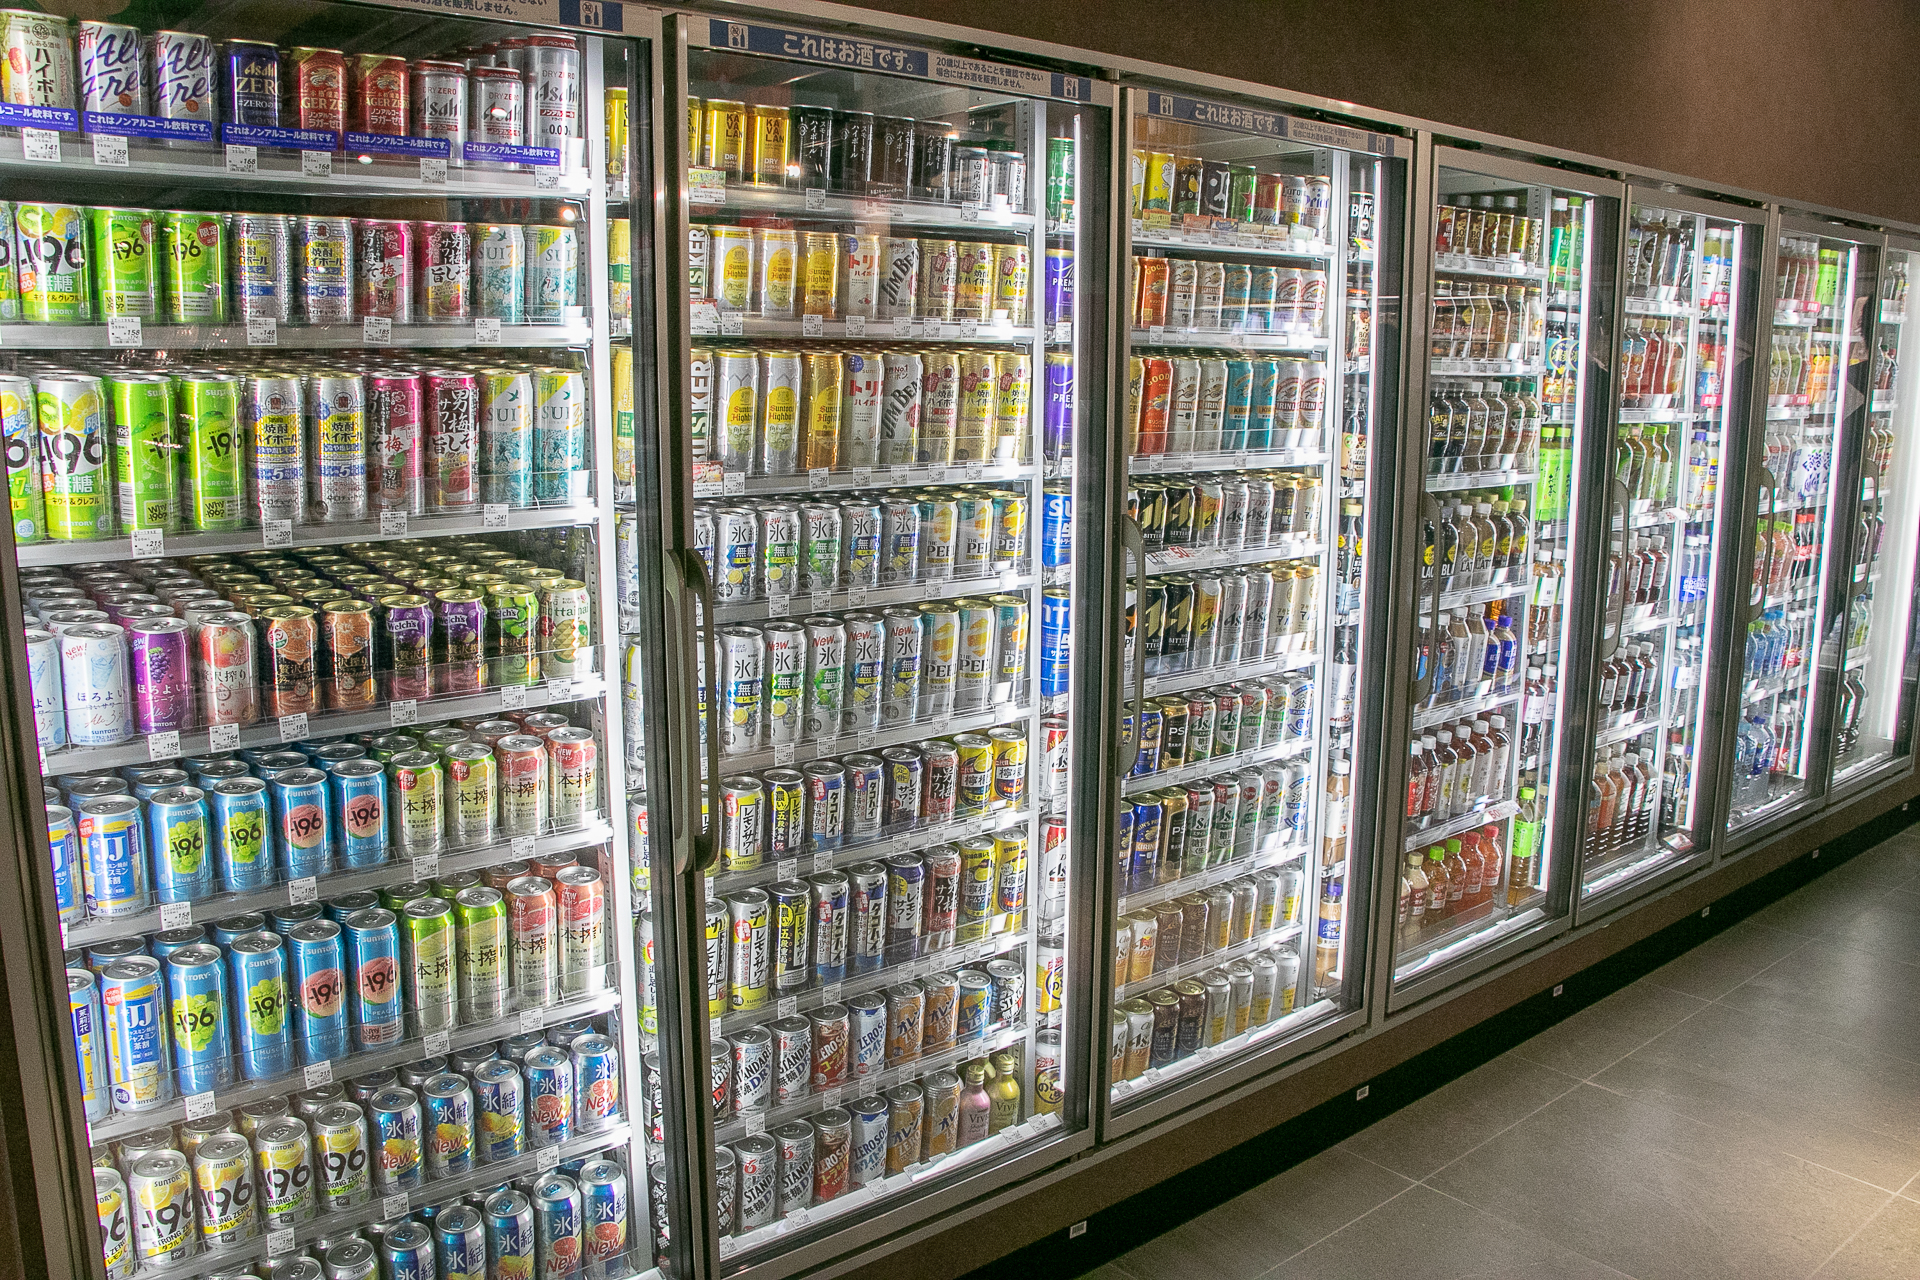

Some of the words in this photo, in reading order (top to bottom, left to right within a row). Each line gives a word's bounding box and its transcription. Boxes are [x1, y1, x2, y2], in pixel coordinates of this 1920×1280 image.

[84, 30, 144, 76] All
[157, 38, 217, 82] All
[783, 31, 915, 73] これはお酒です。
[244, 61, 276, 76] Asahi
[542, 69, 557, 78] DRY
[936, 56, 1044, 82] 20歳以上であることを確認できない
[936, 67, 1026, 90] 場合にはお酒を販売しません。
[437, 87, 457, 95] ZERO
[416, 97, 462, 118] Asahi
[726, 113, 740, 123] KA
[1194, 102, 1280, 133] これはお酒です。
[88, 114, 209, 133] これはノンアルコール飲料です。
[726, 122, 740, 131] VA
[766, 118, 780, 127] KA
[766, 126, 780, 136] VA
[226, 125, 335, 143] これはノンアルコール飲料です。
[348, 134, 449, 151] これはノンアルコール飲料です。
[765, 134, 785, 144] LAN
[850, 124, 860, 159] ハイボール
[466, 144, 559, 159] これはノンアルコール飲料です。
[724, 153, 738, 161] DRY
[894, 130, 904, 164] ハイボール
[926, 134, 936, 167] ハイボール
[764, 157, 778, 165] DRY
[972, 160, 982, 200] 白角水割
[200, 222, 218, 237] 限定
[476, 247, 507, 260] SUI
[545, 248, 571, 262] SUI
[36, 273, 74, 293] 無糖
[1146, 374, 1169, 387] GOOD
[439, 398, 451, 433] サワー
[449, 388, 468, 434] 男梅
[486, 407, 517, 422] SUI
[1173, 401, 1196, 411] KIRIN
[264, 423, 288, 435] 焼酎
[331, 422, 355, 433] 焼酎
[54, 473, 94, 494] 無糖
[147, 501, 167, 515] Why
[205, 500, 225, 513] Why
[386, 618, 419, 632] Welch's
[766, 639, 789, 652] New
[811, 634, 836, 648] New
[848, 629, 872, 643] New
[76, 688, 127, 703] ほろよい
[136, 681, 186, 696] ほろよい
[91, 726, 120, 735] SUNTORY
[556, 748, 573, 757] NEW
[453, 764, 469, 774] NEW
[898, 785, 909, 808] サワー
[909, 778, 917, 805] レモン
[931, 773, 943, 799] サワー
[867, 781, 878, 819] タコハイ
[290, 811, 323, 838] -196
[348, 805, 380, 828] -196
[828, 791, 839, 837] タコハイ
[229, 822, 262, 849] -196
[742, 806, 755, 856] レモンサワー
[95, 836, 124, 862] JJ
[170, 832, 204, 859] -196
[100, 905, 132, 914] SUNTORY
[906, 892, 916, 921] レモン
[934, 885, 944, 913] サワー
[893, 899, 906, 923] サワー
[833, 909, 844, 965] タコハイ
[868, 902, 882, 955] タコハイ
[459, 944, 507, 968] 本搾り
[752, 929, 766, 986] レモンサワー
[307, 979, 344, 1005] -196
[363, 969, 398, 994] -196
[126, 1002, 152, 1029] JJ
[251, 992, 287, 1020] -196
[175, 1008, 216, 1033] -196
[132, 1040, 150, 1051] 茶割
[539, 1073, 570, 1095] 氷結
[776, 1067, 798, 1088] 無糖
[115, 1091, 129, 1101] お酒
[132, 1095, 162, 1105] SUNTORY
[483, 1091, 516, 1112] 氷結
[437, 1101, 468, 1124] 氷結
[531, 1104, 565, 1125] New
[324, 1126, 352, 1136] SUNTORY
[385, 1115, 418, 1139] 氷結
[430, 1136, 463, 1155] New
[206, 1158, 237, 1170] SUNTORY
[379, 1150, 413, 1171] New
[153, 1172, 183, 1189] SUNTORY
[321, 1177, 349, 1192] STRONG
[348, 1168, 364, 1184] ZERO
[291, 1185, 308, 1200] ZERO
[780, 1183, 802, 1205] 無糖
[231, 1203, 250, 1219] ZERO
[594, 1194, 627, 1220] 氷結
[743, 1200, 766, 1219] 無糖
[151, 1228, 181, 1248] STRONG
[499, 1226, 534, 1254] 氷結
[446, 1243, 485, 1270] 氷結
[545, 1251, 579, 1273] New
